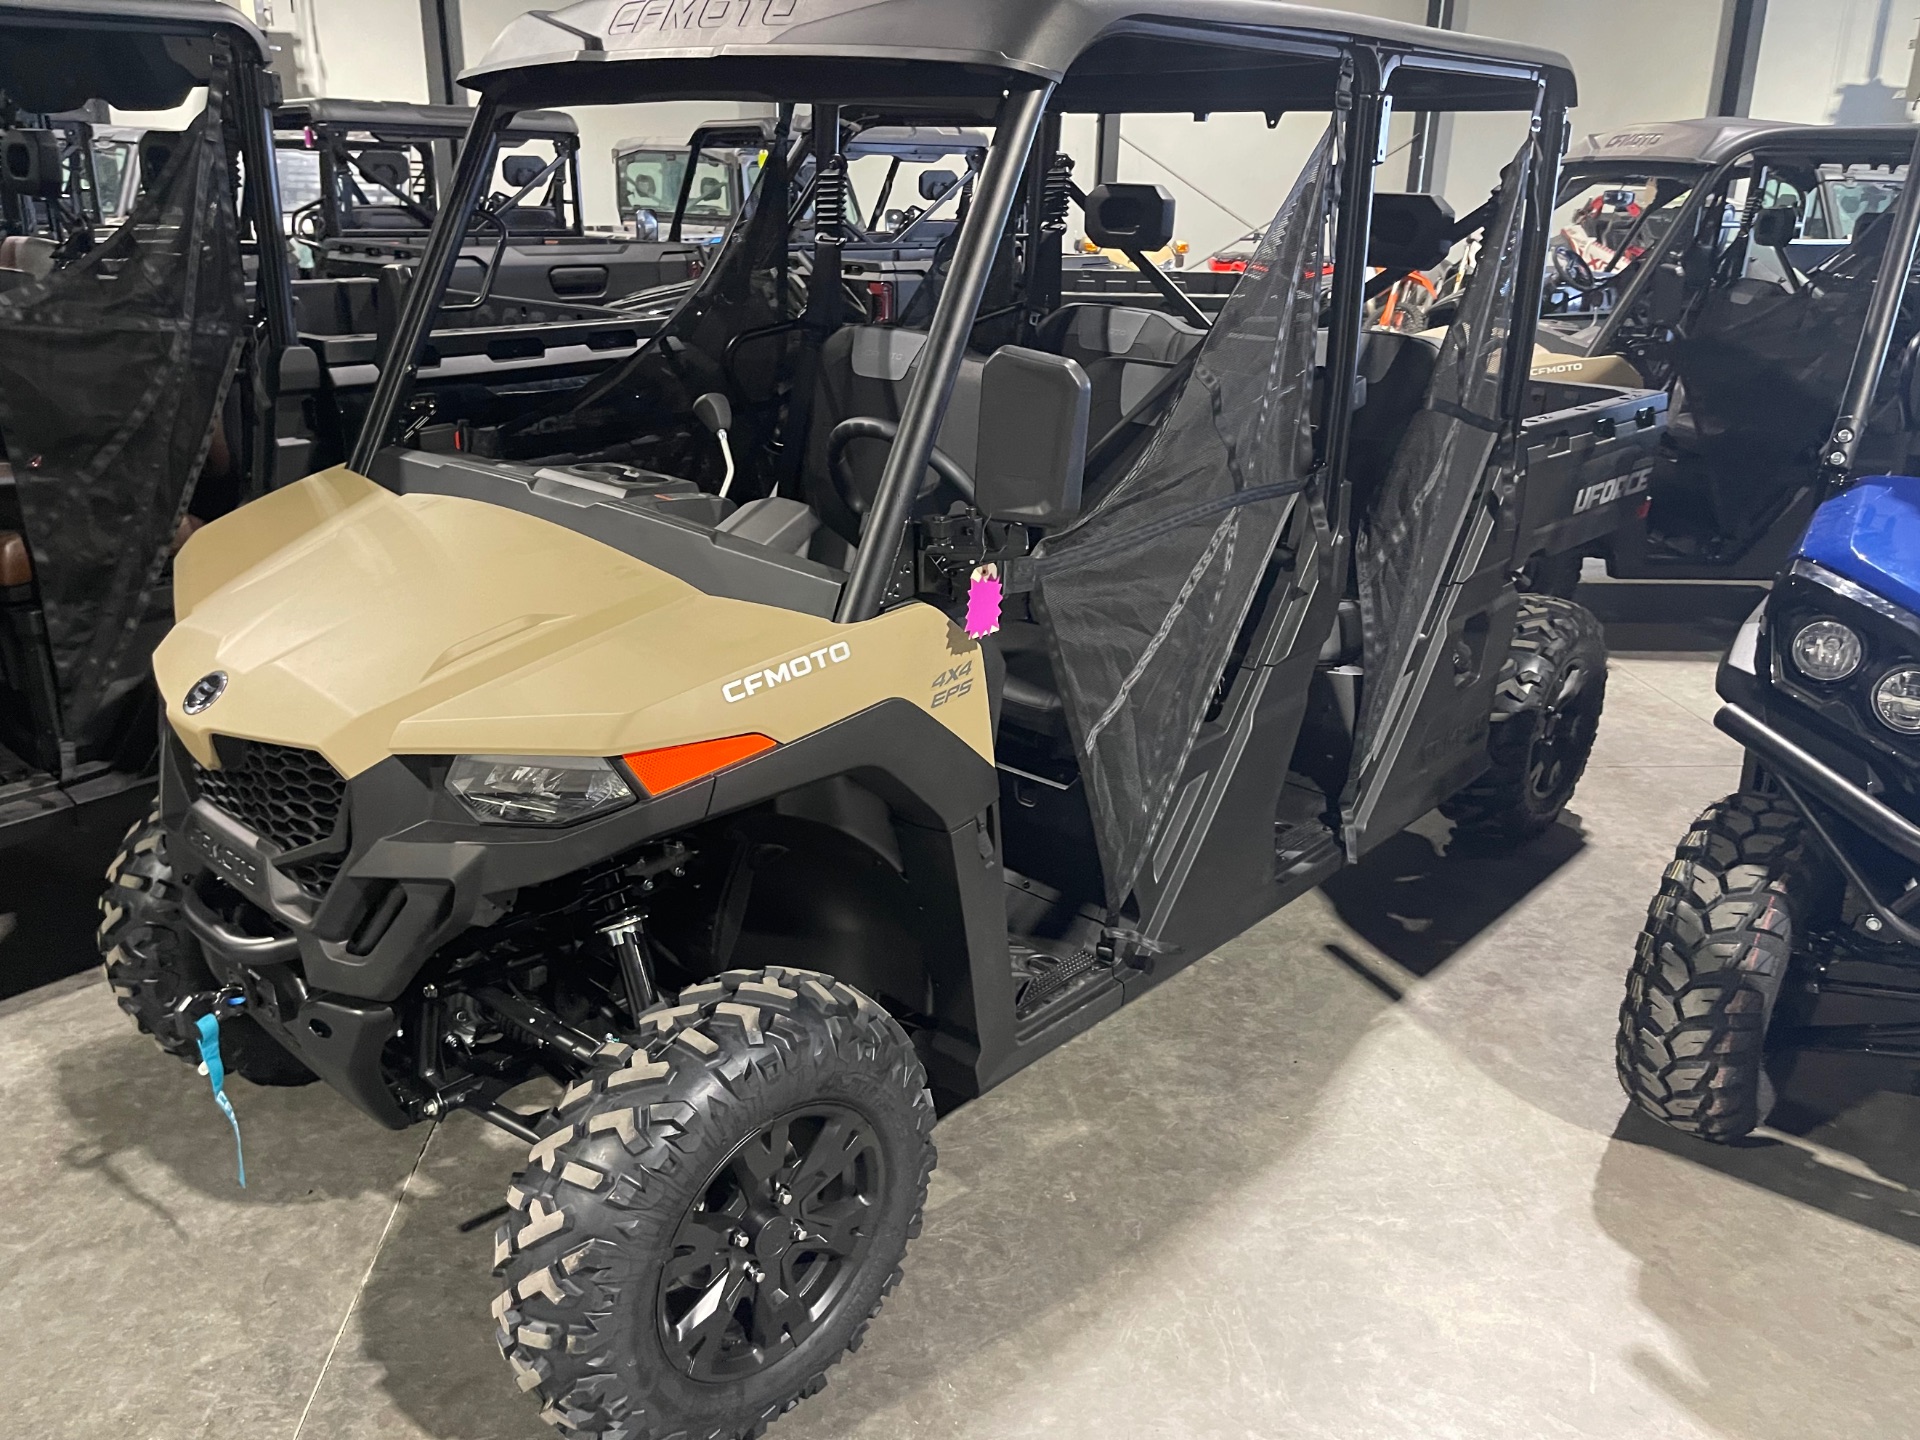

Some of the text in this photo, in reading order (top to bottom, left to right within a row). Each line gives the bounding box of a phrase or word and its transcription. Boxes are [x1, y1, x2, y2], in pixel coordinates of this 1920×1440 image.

[608, 0, 798, 36] CFMOTO
[1530, 363, 1583, 376] CFMOTO
[1572, 467, 1654, 515] UFORCE
[721, 641, 851, 703] CFMOTO
[931, 660, 973, 689] 4X4
[930, 678, 974, 709] EPS
